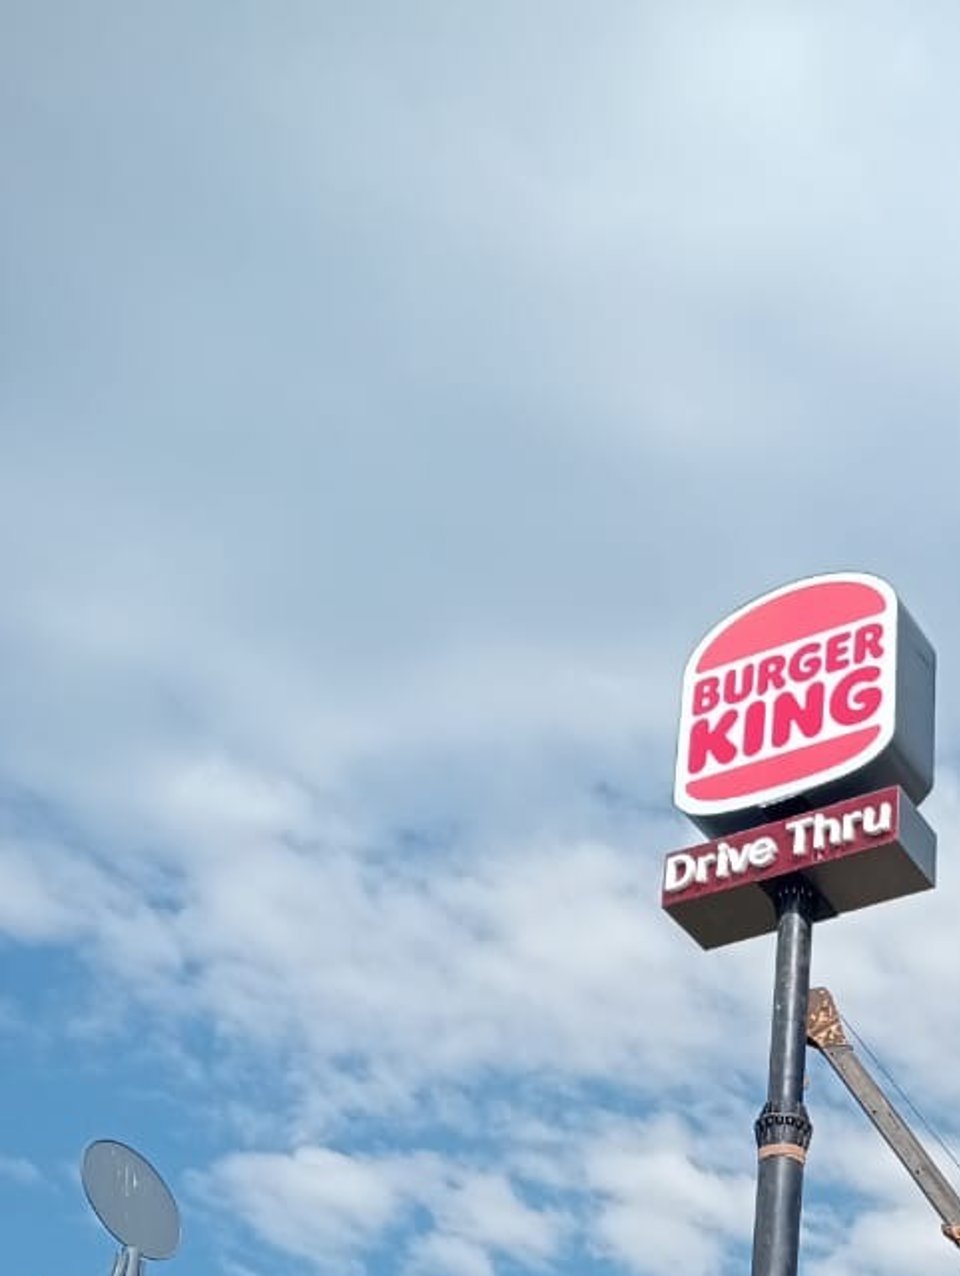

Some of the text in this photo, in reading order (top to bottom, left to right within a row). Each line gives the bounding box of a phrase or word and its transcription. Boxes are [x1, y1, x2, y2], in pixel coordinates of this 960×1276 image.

[692, 622, 884, 717] BURGER
[687, 665, 882, 775] KING
[664, 800, 893, 893] Drive Thru
